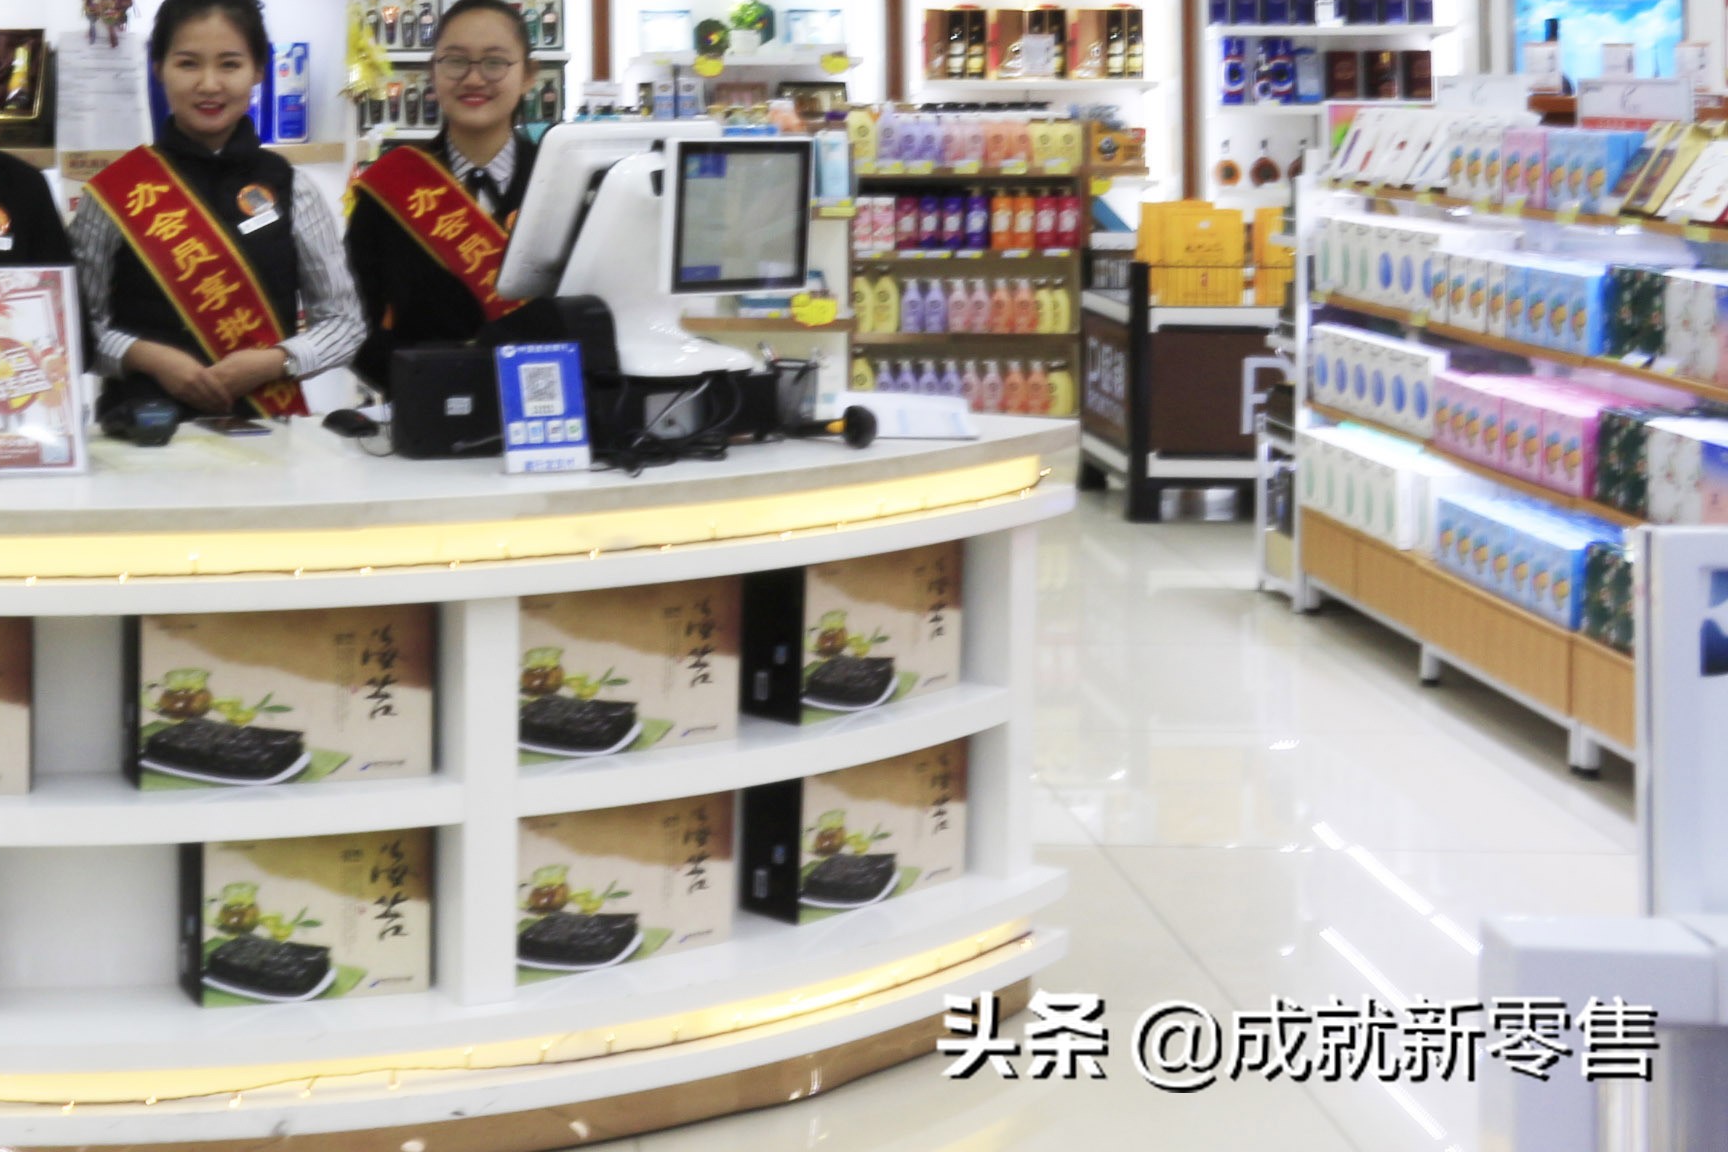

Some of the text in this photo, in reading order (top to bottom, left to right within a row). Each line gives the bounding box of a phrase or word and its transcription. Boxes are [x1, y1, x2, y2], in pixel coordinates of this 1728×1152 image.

[125, 181, 268, 350] 办会员享批
